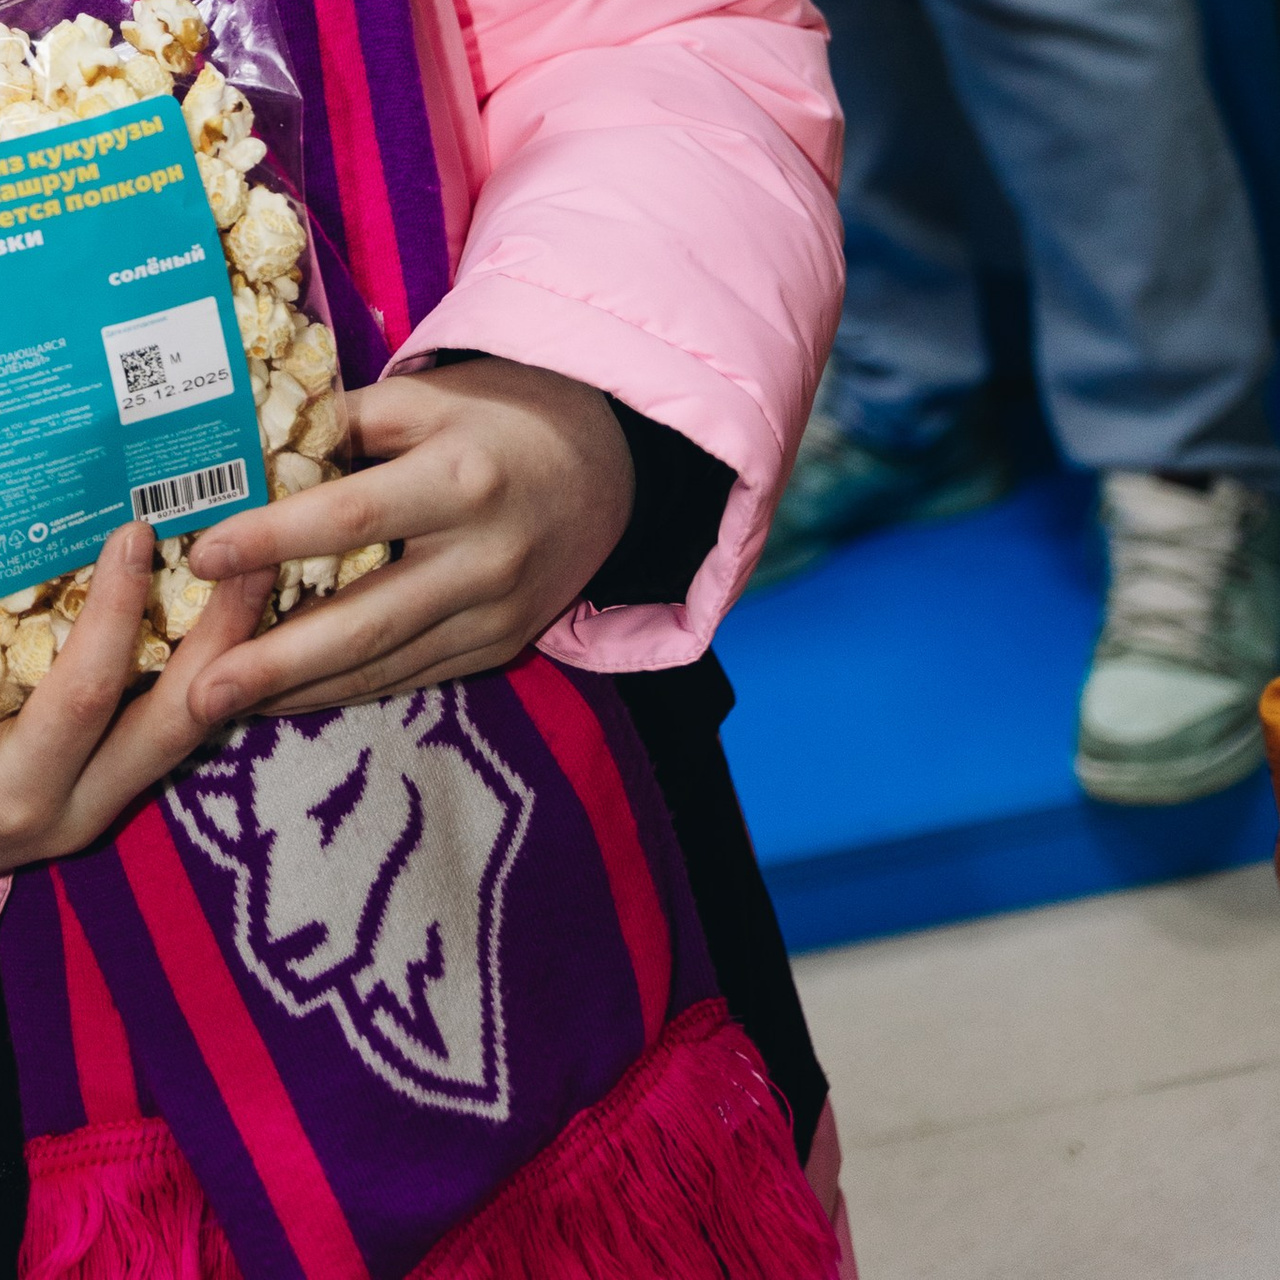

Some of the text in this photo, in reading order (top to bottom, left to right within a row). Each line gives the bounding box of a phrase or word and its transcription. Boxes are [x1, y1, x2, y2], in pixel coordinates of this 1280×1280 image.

[27, 115, 164, 170] кукурузы
[64, 164, 185, 213] попкорн
[108, 243, 206, 286] солёный
[122, 368, 229, 410] 25.12.2025
[61, 546, 69, 556] 9
